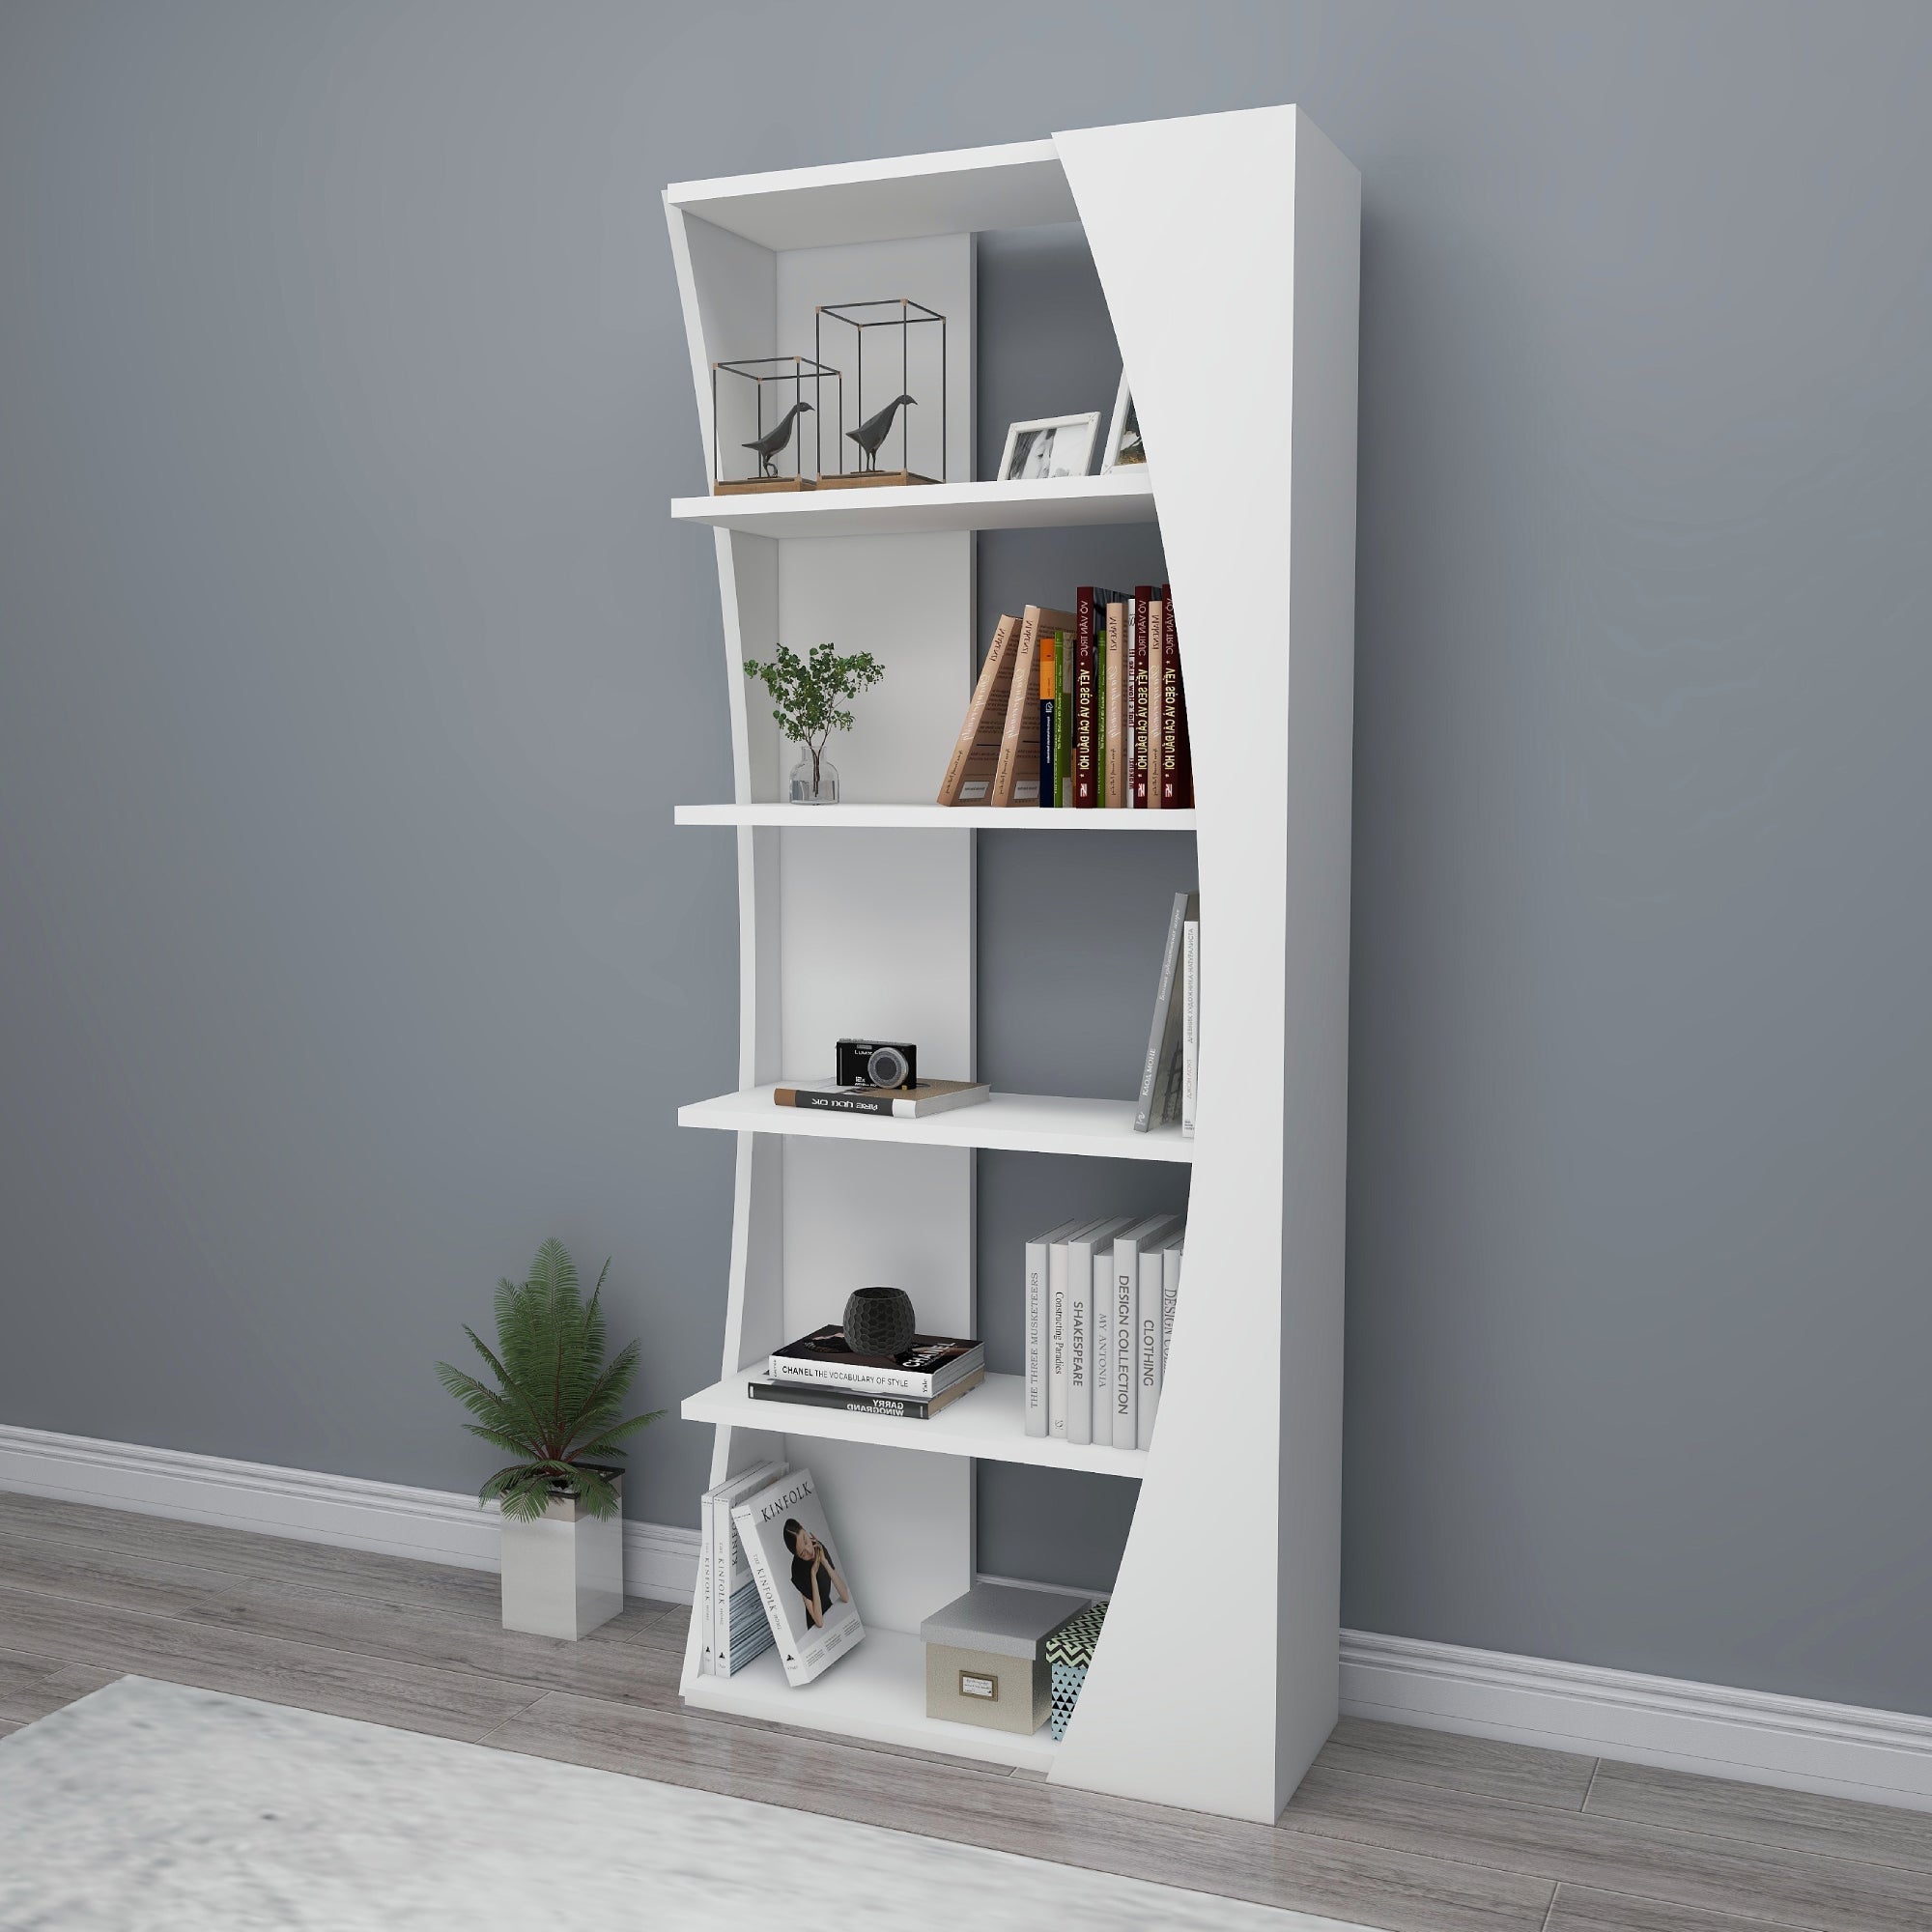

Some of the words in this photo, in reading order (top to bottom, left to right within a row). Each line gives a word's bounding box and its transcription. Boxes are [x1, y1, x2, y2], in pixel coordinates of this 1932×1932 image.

[1146, 1048, 1156, 1074] МОНЕ
[1030, 1272, 1038, 1346] MUSKETEERS
[1053, 1292, 1065, 1341] Constructing
[1119, 1275, 1129, 1325] DESIGN
[1098, 1313, 1107, 1331] MY
[901, 1342, 956, 1368] CHANEL
[1073, 1301, 1084, 1387] SHAKESPEARE
[1143, 1320, 1154, 1386] CLOTHING
[781, 1365, 813, 1377] CHANEL
[814, 1369, 828, 1378] THE
[829, 1371, 875, 1384] VOCABULARY
[876, 1377, 886, 1385] OF
[887, 1378, 909, 1388] STYLE
[1030, 1349, 1038, 1384] THREE
[1118, 1329, 1129, 1414] COLLECTION
[1030, 1387, 1038, 1408] THE
[760, 1480, 812, 1522] KINFOLK
[756, 1568, 777, 1612] KINFOLK
